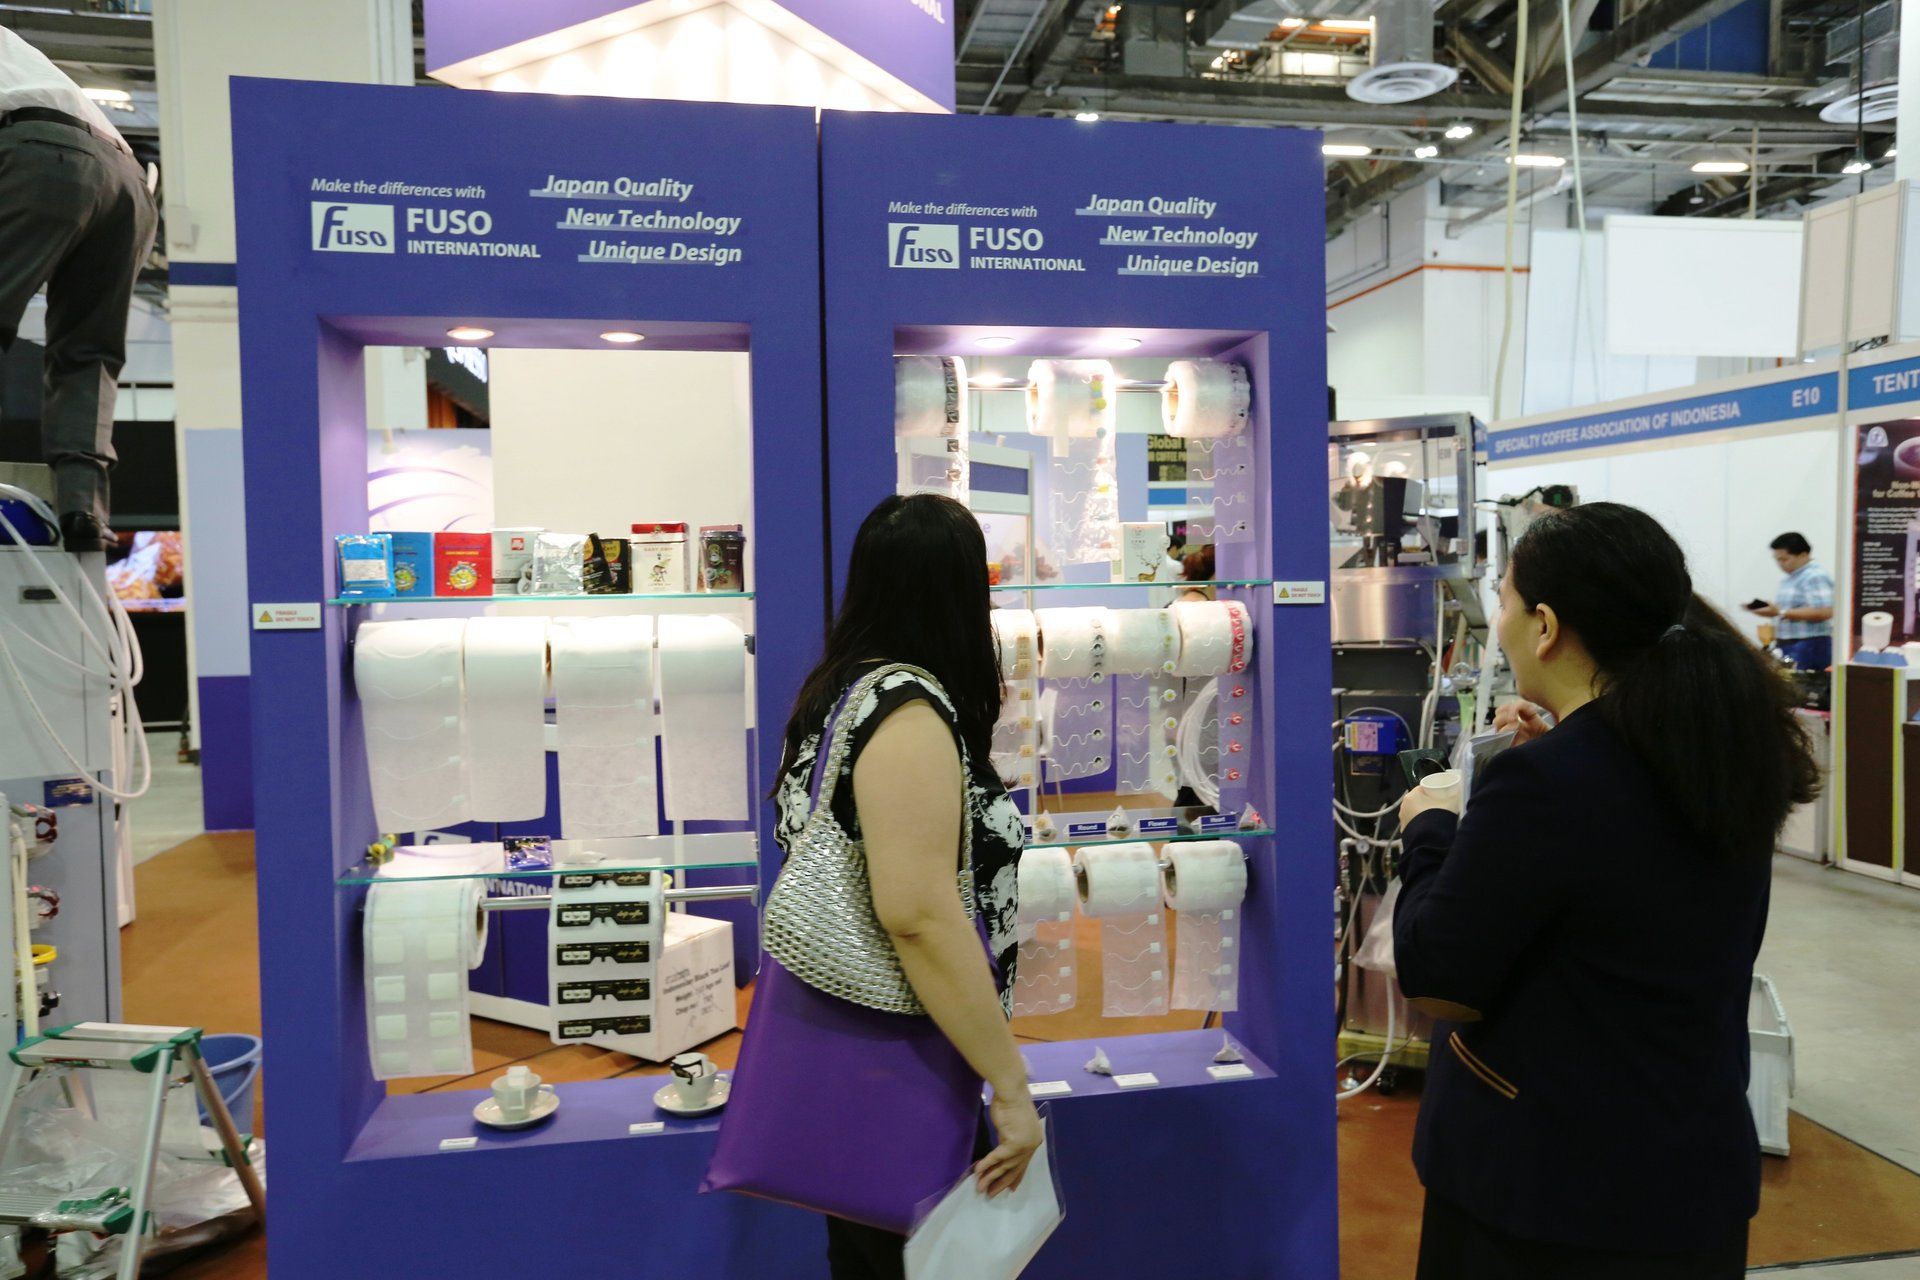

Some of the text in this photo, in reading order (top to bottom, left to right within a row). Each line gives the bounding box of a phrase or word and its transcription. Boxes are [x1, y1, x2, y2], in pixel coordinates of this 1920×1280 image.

[311, 178, 486, 198] Make the differences with
[543, 174, 694, 202] Japan Quality
[888, 202, 1038, 218] Make the differences with
[1086, 194, 1217, 219] Japan Quality
[407, 208, 492, 235] FUSO
[566, 208, 742, 236] New Technology
[407, 240, 542, 258] INTERNATIONAL
[970, 227, 1044, 251] FUSO
[1107, 225, 1258, 249] New Technology
[589, 240, 742, 266] Unique Design
[970, 256, 1086, 272] INTERNATIONAL
[1126, 254, 1259, 278] Unique Design
[1792, 386, 1820, 408] E10
[1494, 434, 1540, 454] SPECIALTY
[1542, 428, 1580, 446] COFFEE
[1580, 416, 1650, 440] ASSOCIATION
[1652, 412, 1669, 430] OF
[1671, 401, 1741, 427] INDONESIA
